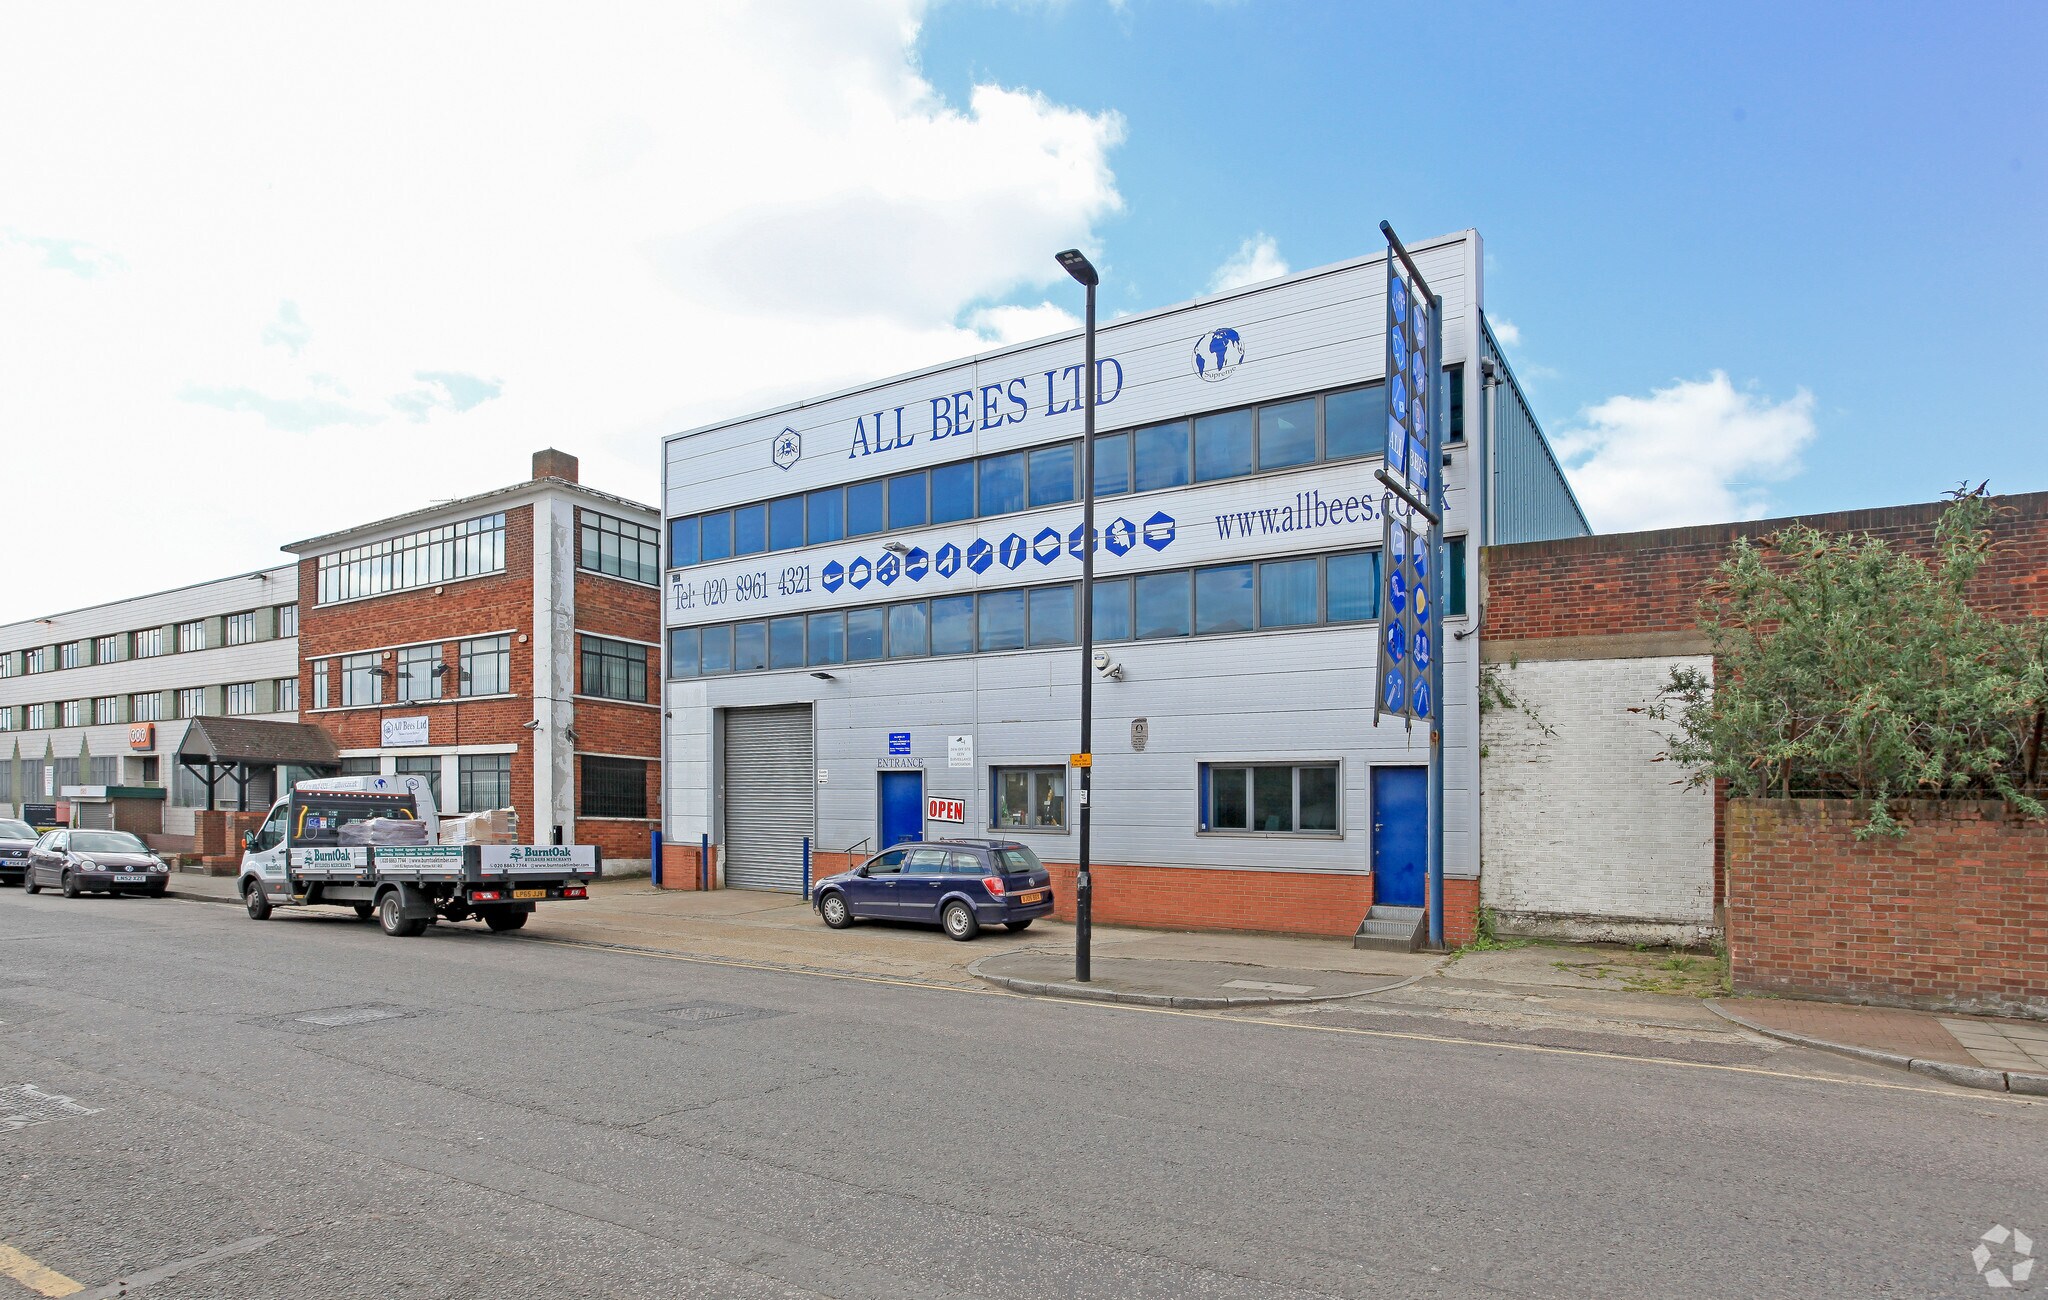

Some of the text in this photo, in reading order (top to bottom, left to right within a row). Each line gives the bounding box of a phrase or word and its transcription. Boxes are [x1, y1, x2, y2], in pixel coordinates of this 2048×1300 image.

[1204, 366, 1237, 379] Supreme
[849, 357, 1123, 459] ALL BEES LTD
[1389, 431, 1427, 478] ALL BEES
[1215, 483, 1451, 540] www.allbees.co.k
[673, 564, 812, 610] Tel: 020 8961 4321
[877, 758, 924, 768] ENTRANCE
[929, 800, 963, 820] OPEN
[314, 848, 351, 862] BurntOak
[525, 846, 571, 857] BurntOak
